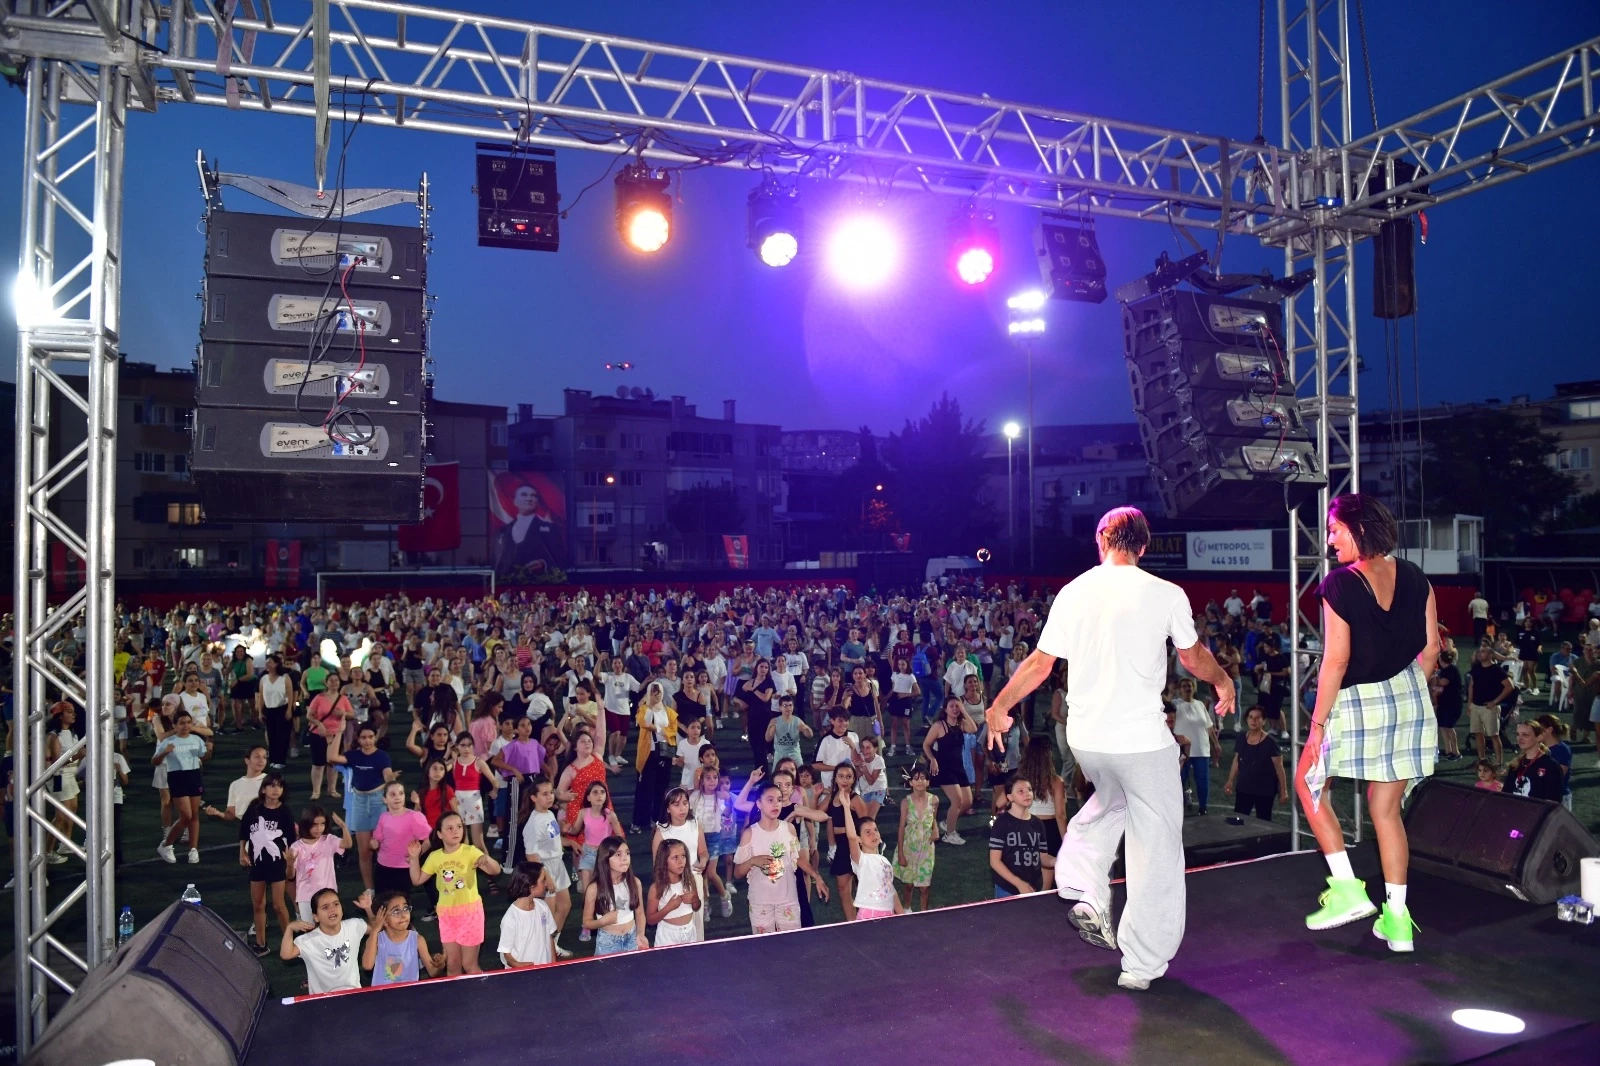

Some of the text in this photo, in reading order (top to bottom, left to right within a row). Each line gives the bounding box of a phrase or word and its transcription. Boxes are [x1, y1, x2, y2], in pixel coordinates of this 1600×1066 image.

[276, 439, 309, 447] event
[1147, 536, 1182, 552] URAT
[1207, 542, 1251, 551] METROPOL
[1211, 555, 1250, 565] 444 35 50
